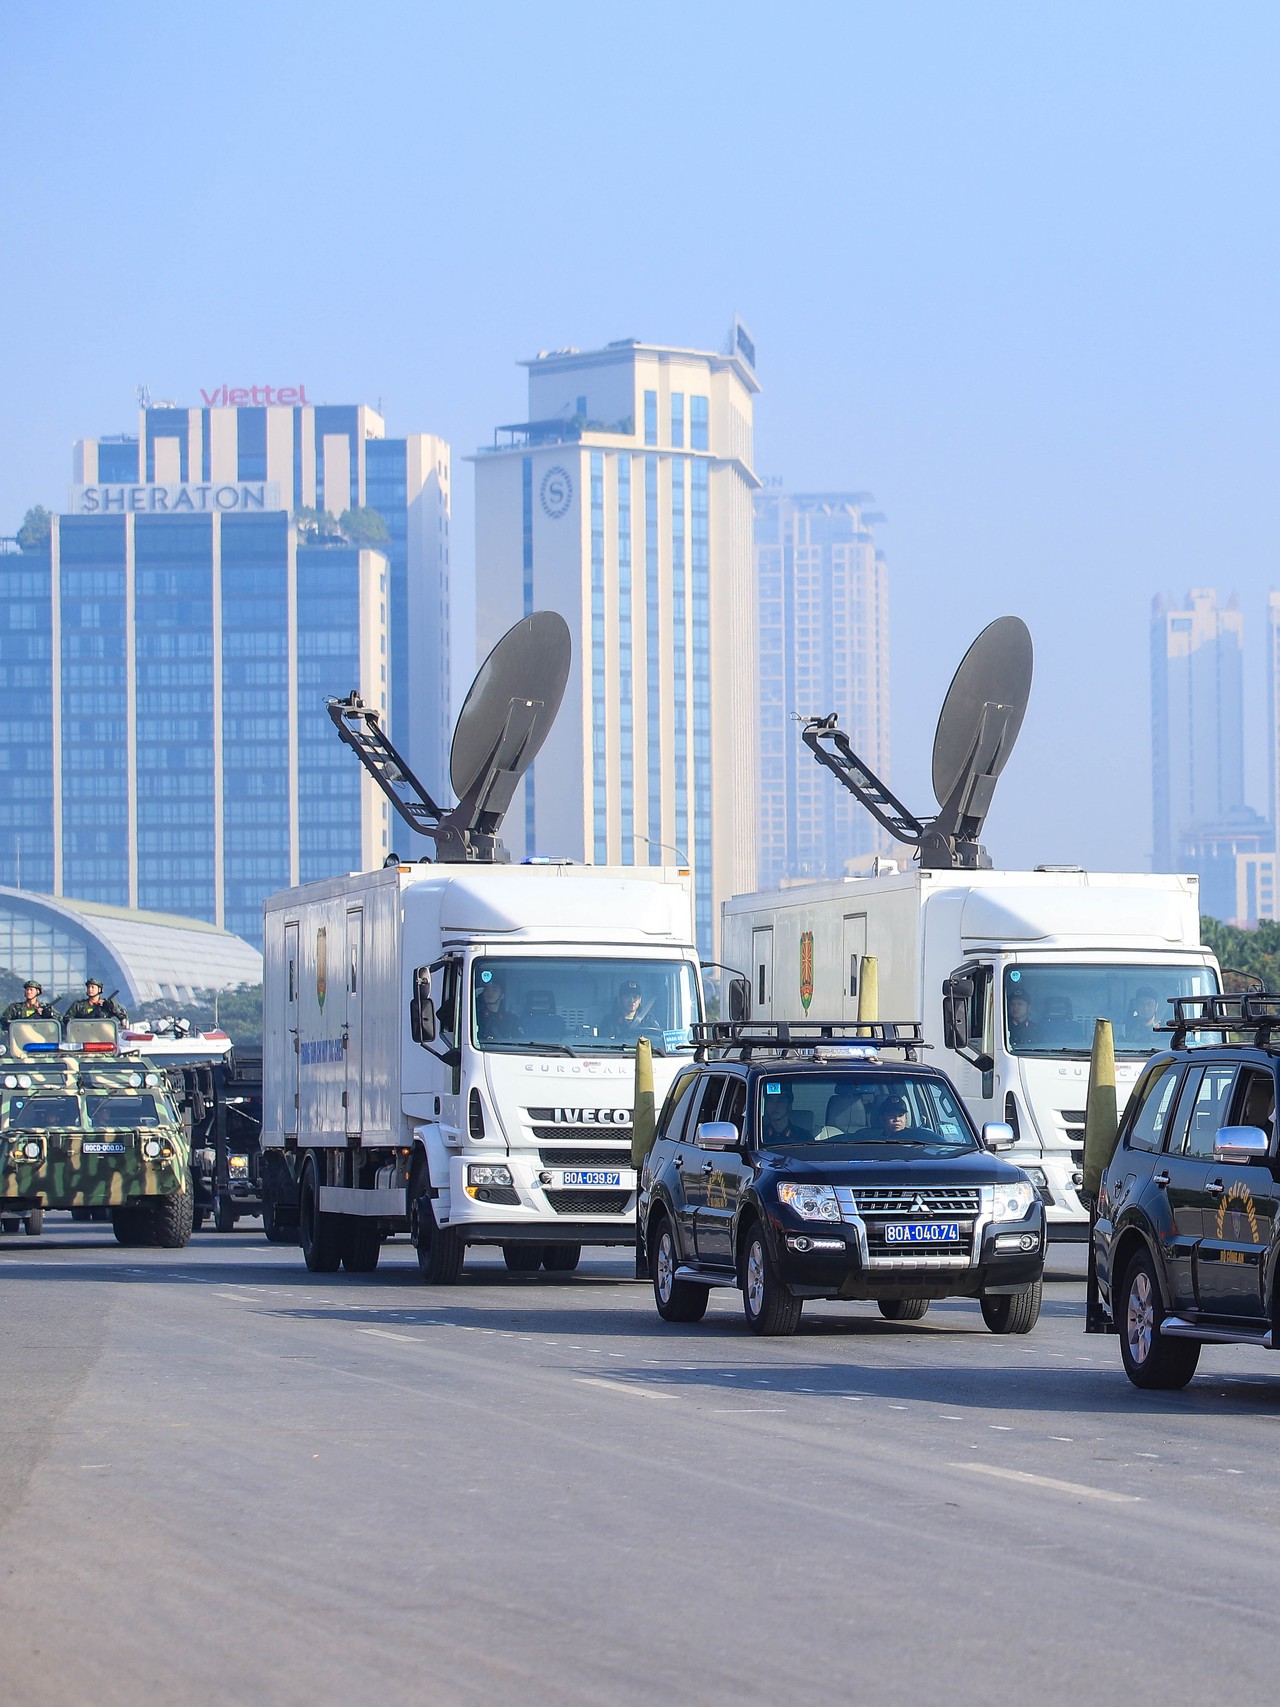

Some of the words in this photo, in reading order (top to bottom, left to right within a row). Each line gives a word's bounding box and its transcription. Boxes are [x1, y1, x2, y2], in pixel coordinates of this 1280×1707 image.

[200, 384, 310, 407] viettel
[83, 485, 265, 512] SHERATON
[554, 1108, 631, 1124] IVECO
[564, 1172, 619, 1184] 80A-039.87
[887, 1224, 957, 1241] 80A-040.74
